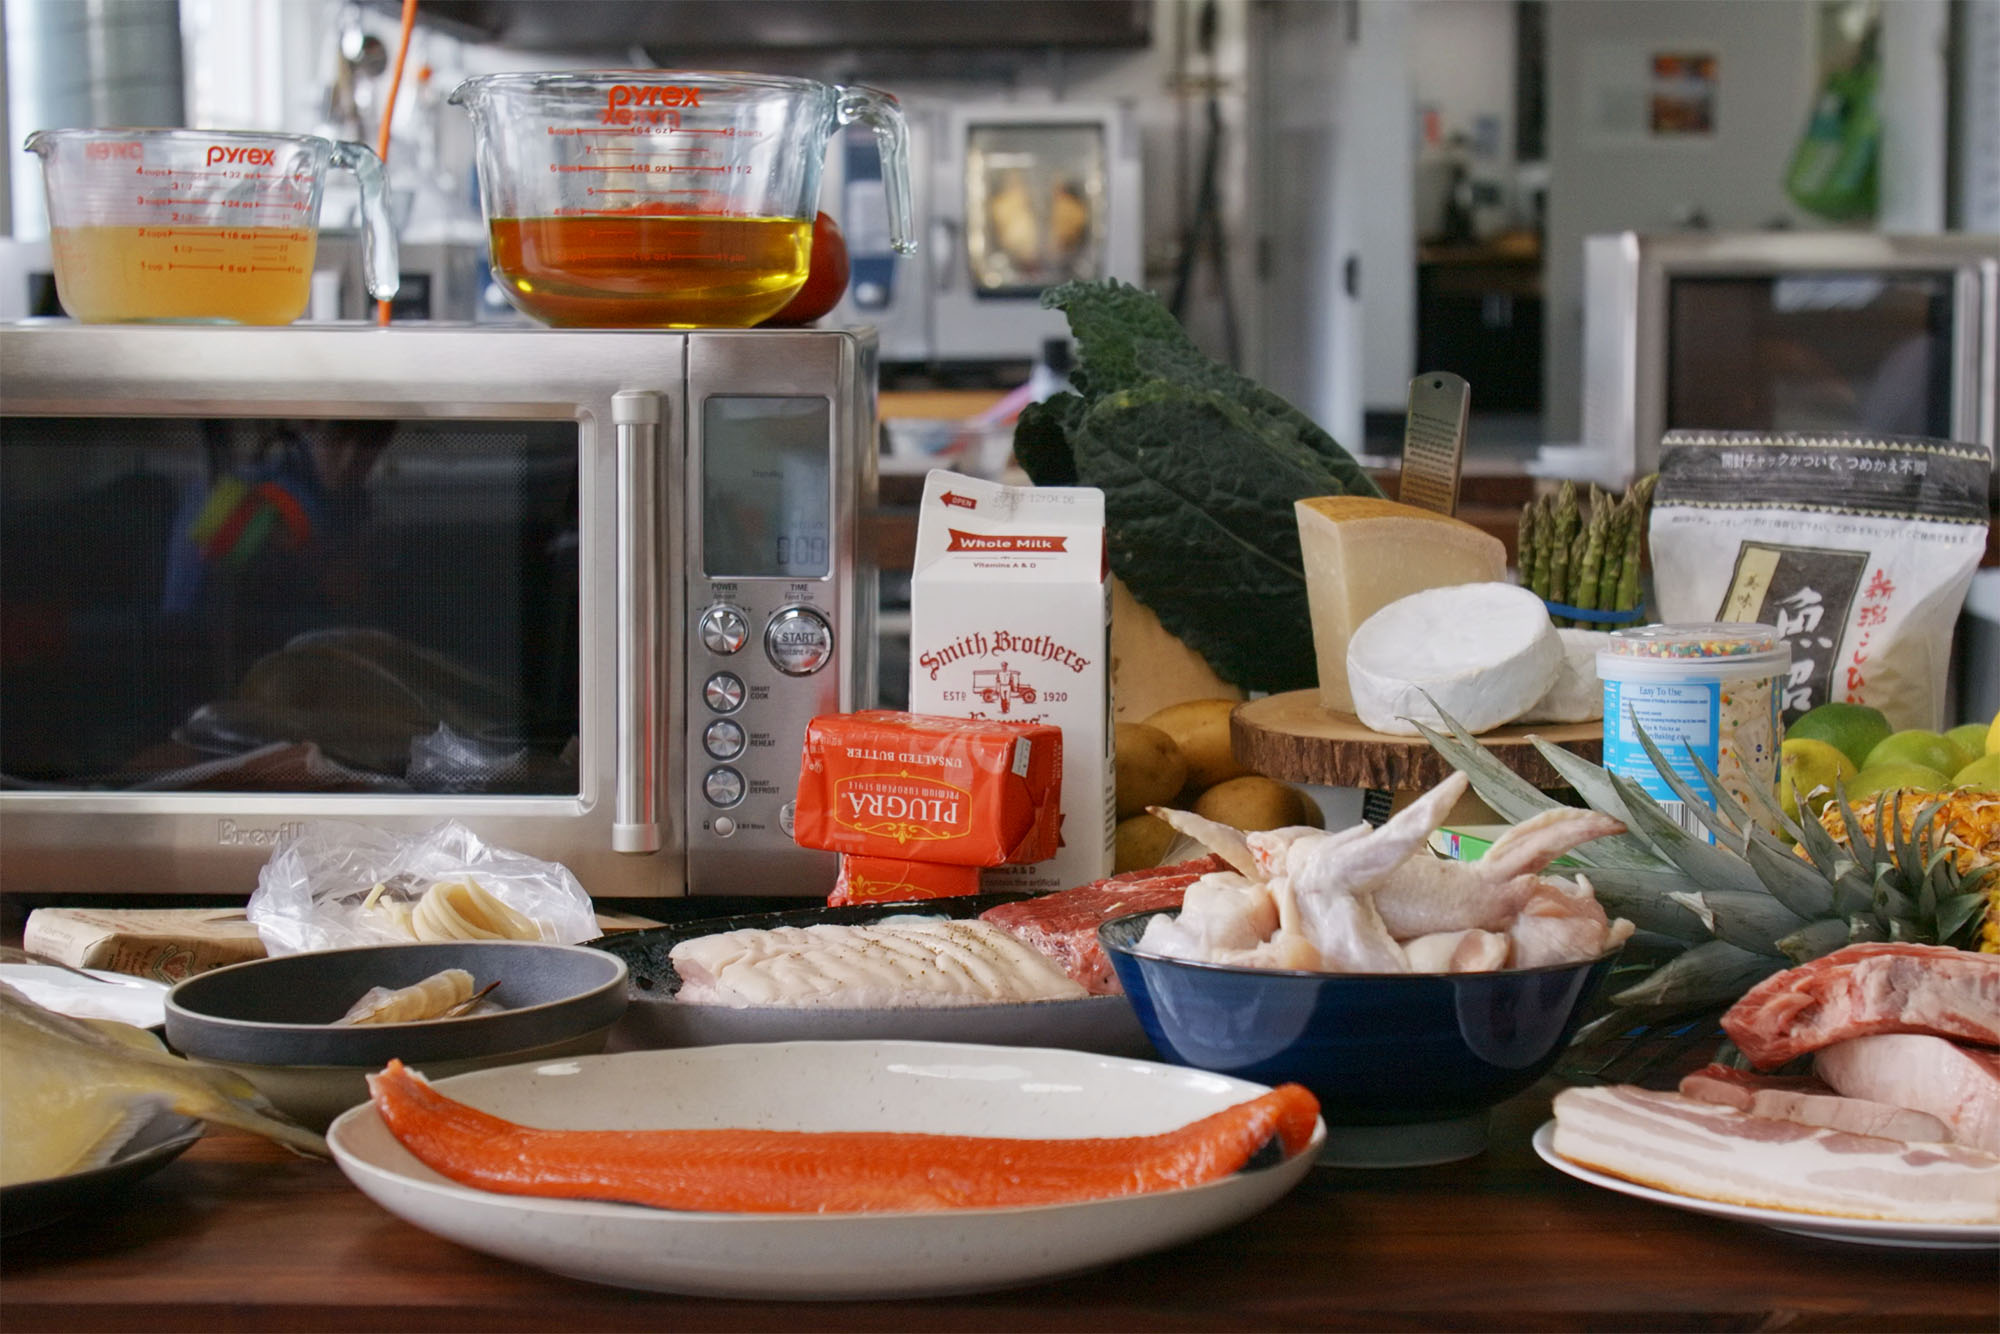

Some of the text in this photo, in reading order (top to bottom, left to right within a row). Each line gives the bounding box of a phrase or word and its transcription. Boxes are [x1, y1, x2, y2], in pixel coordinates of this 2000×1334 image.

[608, 85, 700, 112] pyrex
[728, 128, 736, 136] 2
[586, 146, 592, 154] 7
[207, 146, 275, 166] pyrex
[136, 166, 143, 175] 4
[655, 165, 667, 173] oz
[587, 188, 594, 196] 5
[228, 200, 240, 208] 24
[172, 213, 178, 221] 2
[138, 228, 145, 237] 2
[951, 496, 972, 507] OPEN
[960, 538, 1052, 548] Whole Milk
[712, 583, 738, 591] POWER
[791, 583, 808, 591] TIME
[782, 632, 815, 642] START
[919, 630, 1091, 681] Smith Brothers
[943, 691, 1067, 702] ESTD 1920
[1640, 687, 1682, 697] Easy To Use
[846, 747, 962, 768] UNSALTED BUTTER
[849, 781, 960, 800] PREMIUM EUROPEAN STYLE
[847, 792, 958, 824] PLUGRÁ
[218, 819, 305, 846] Brevill
[1029, 878, 1060, 887] artificial
